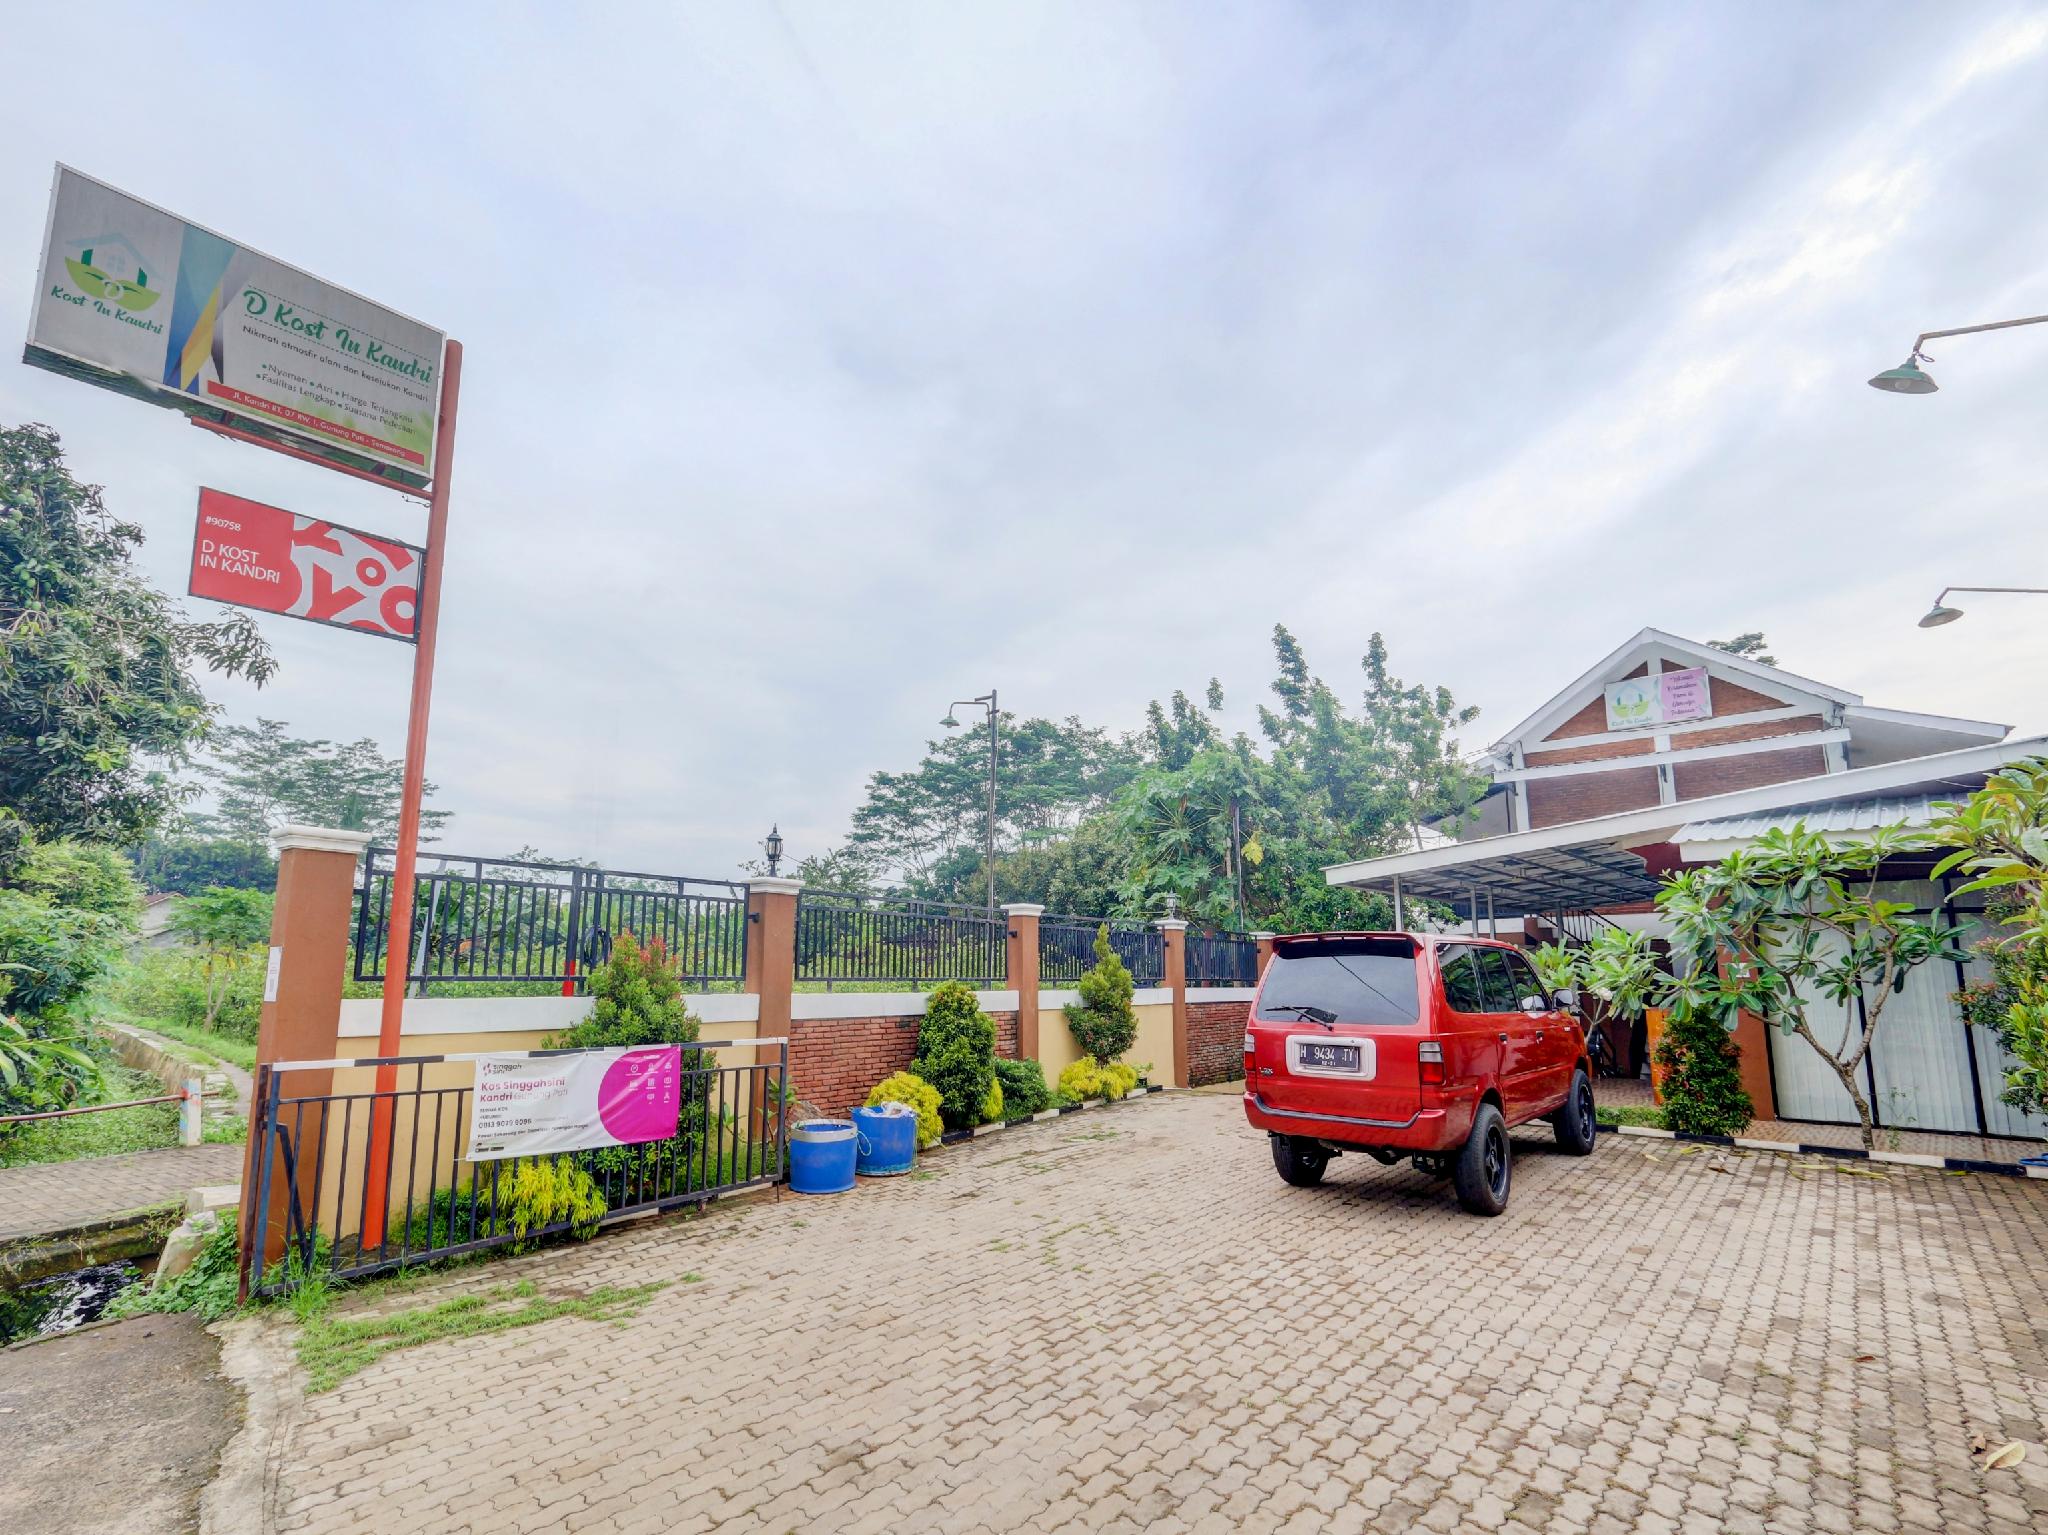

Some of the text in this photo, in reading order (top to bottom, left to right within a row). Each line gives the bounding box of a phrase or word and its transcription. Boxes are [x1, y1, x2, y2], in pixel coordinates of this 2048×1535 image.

[51, 285, 163, 334] Kost In Kandri
[243, 290, 433, 382] D Kost In Kandri
[243, 325, 279, 345] Nikmati
[343, 364, 359, 375] dan
[362, 370, 401, 392] kesejukan
[403, 386, 429, 402] Kandri
[244, 395, 270, 410] Kandri
[269, 364, 413, 424] Nyaman Asri Harga Terjangkau
[300, 387, 336, 407] Lengkap
[344, 403, 377, 421] Suasana
[205, 515, 242, 532] #90758
[202, 539, 259, 564] D KOST
[200, 554, 280, 584] IN KANDRI
[1300, 1045, 1354, 1062] H 9434 TY
[480, 1092, 513, 1102] Kandri
[481, 1081, 501, 1091] Kos
